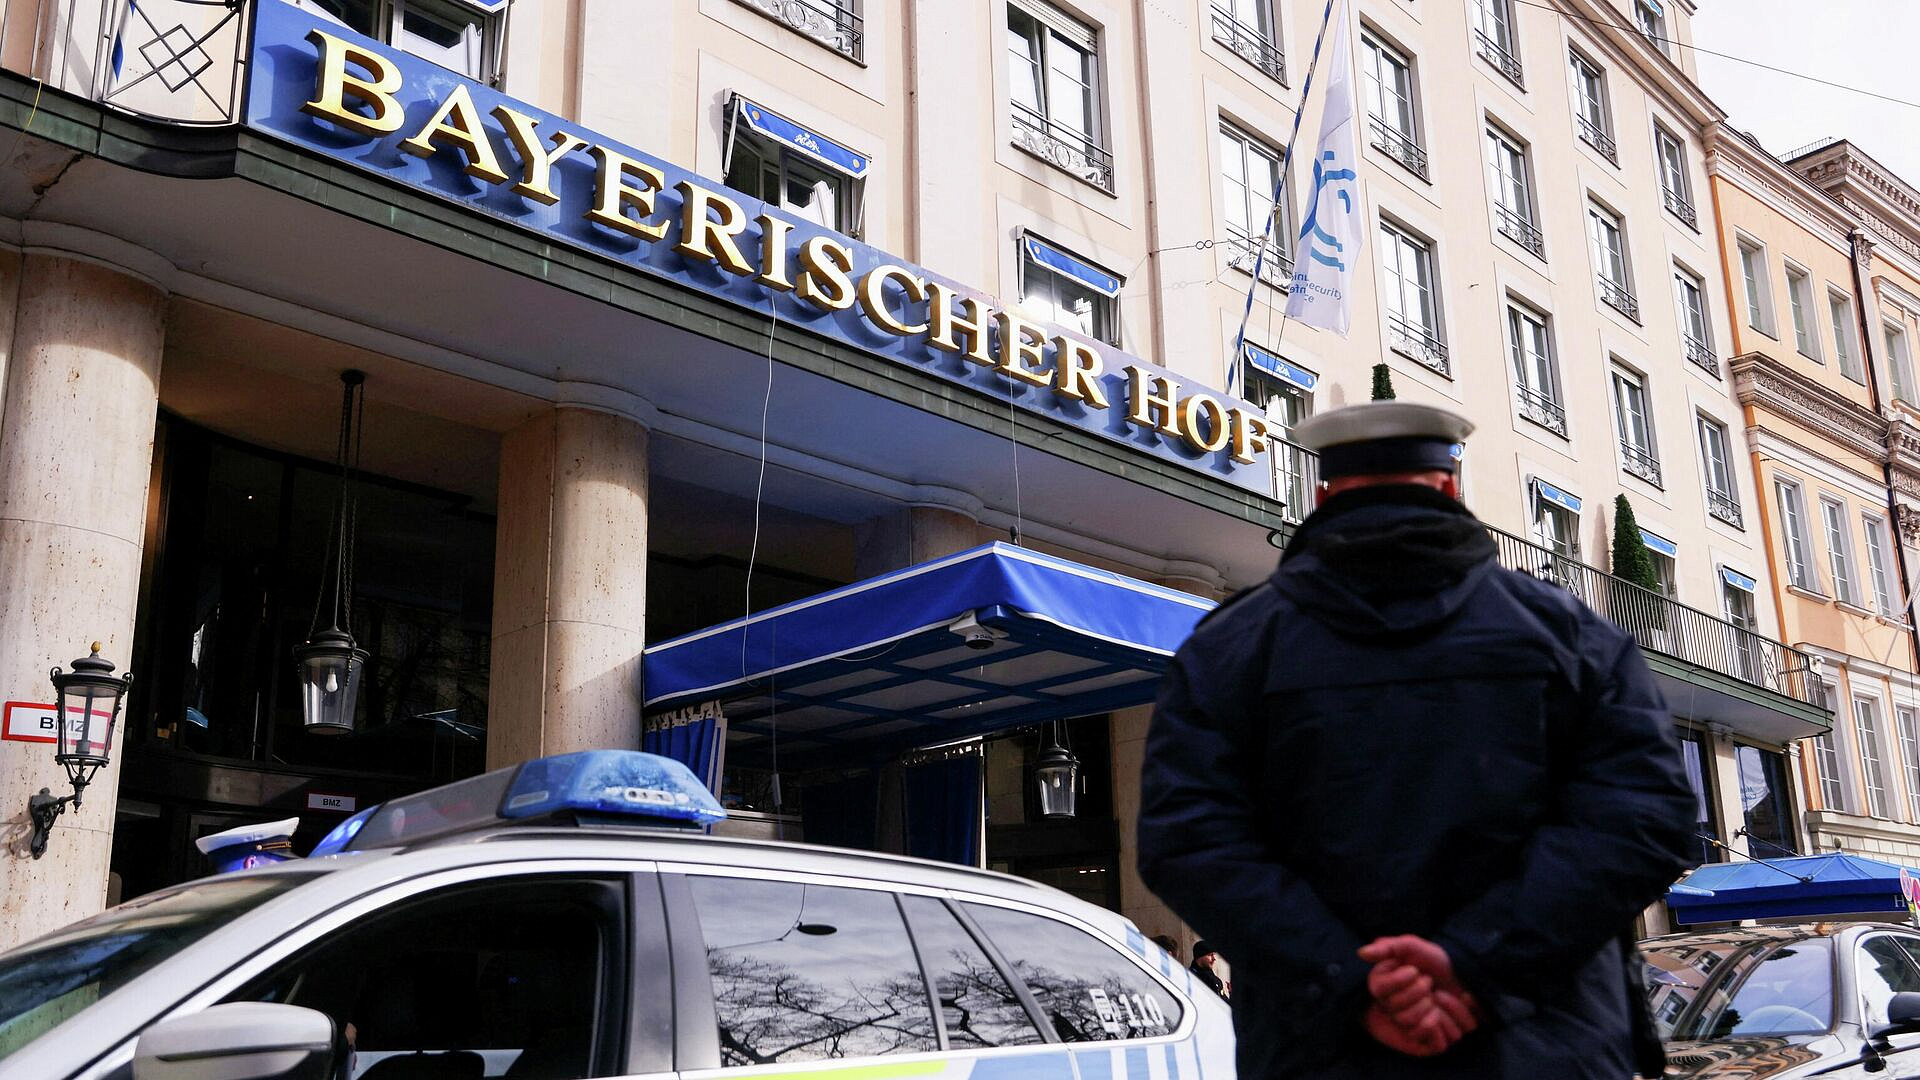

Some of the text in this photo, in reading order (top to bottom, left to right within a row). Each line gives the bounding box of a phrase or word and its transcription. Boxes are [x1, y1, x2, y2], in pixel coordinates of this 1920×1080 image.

[300, 28, 1269, 465] BAYERISCHER HOF
[1306, 282, 1342, 300] ecurity
[322, 798, 341, 807] BMZ
[1118, 993, 1165, 1026] 110
